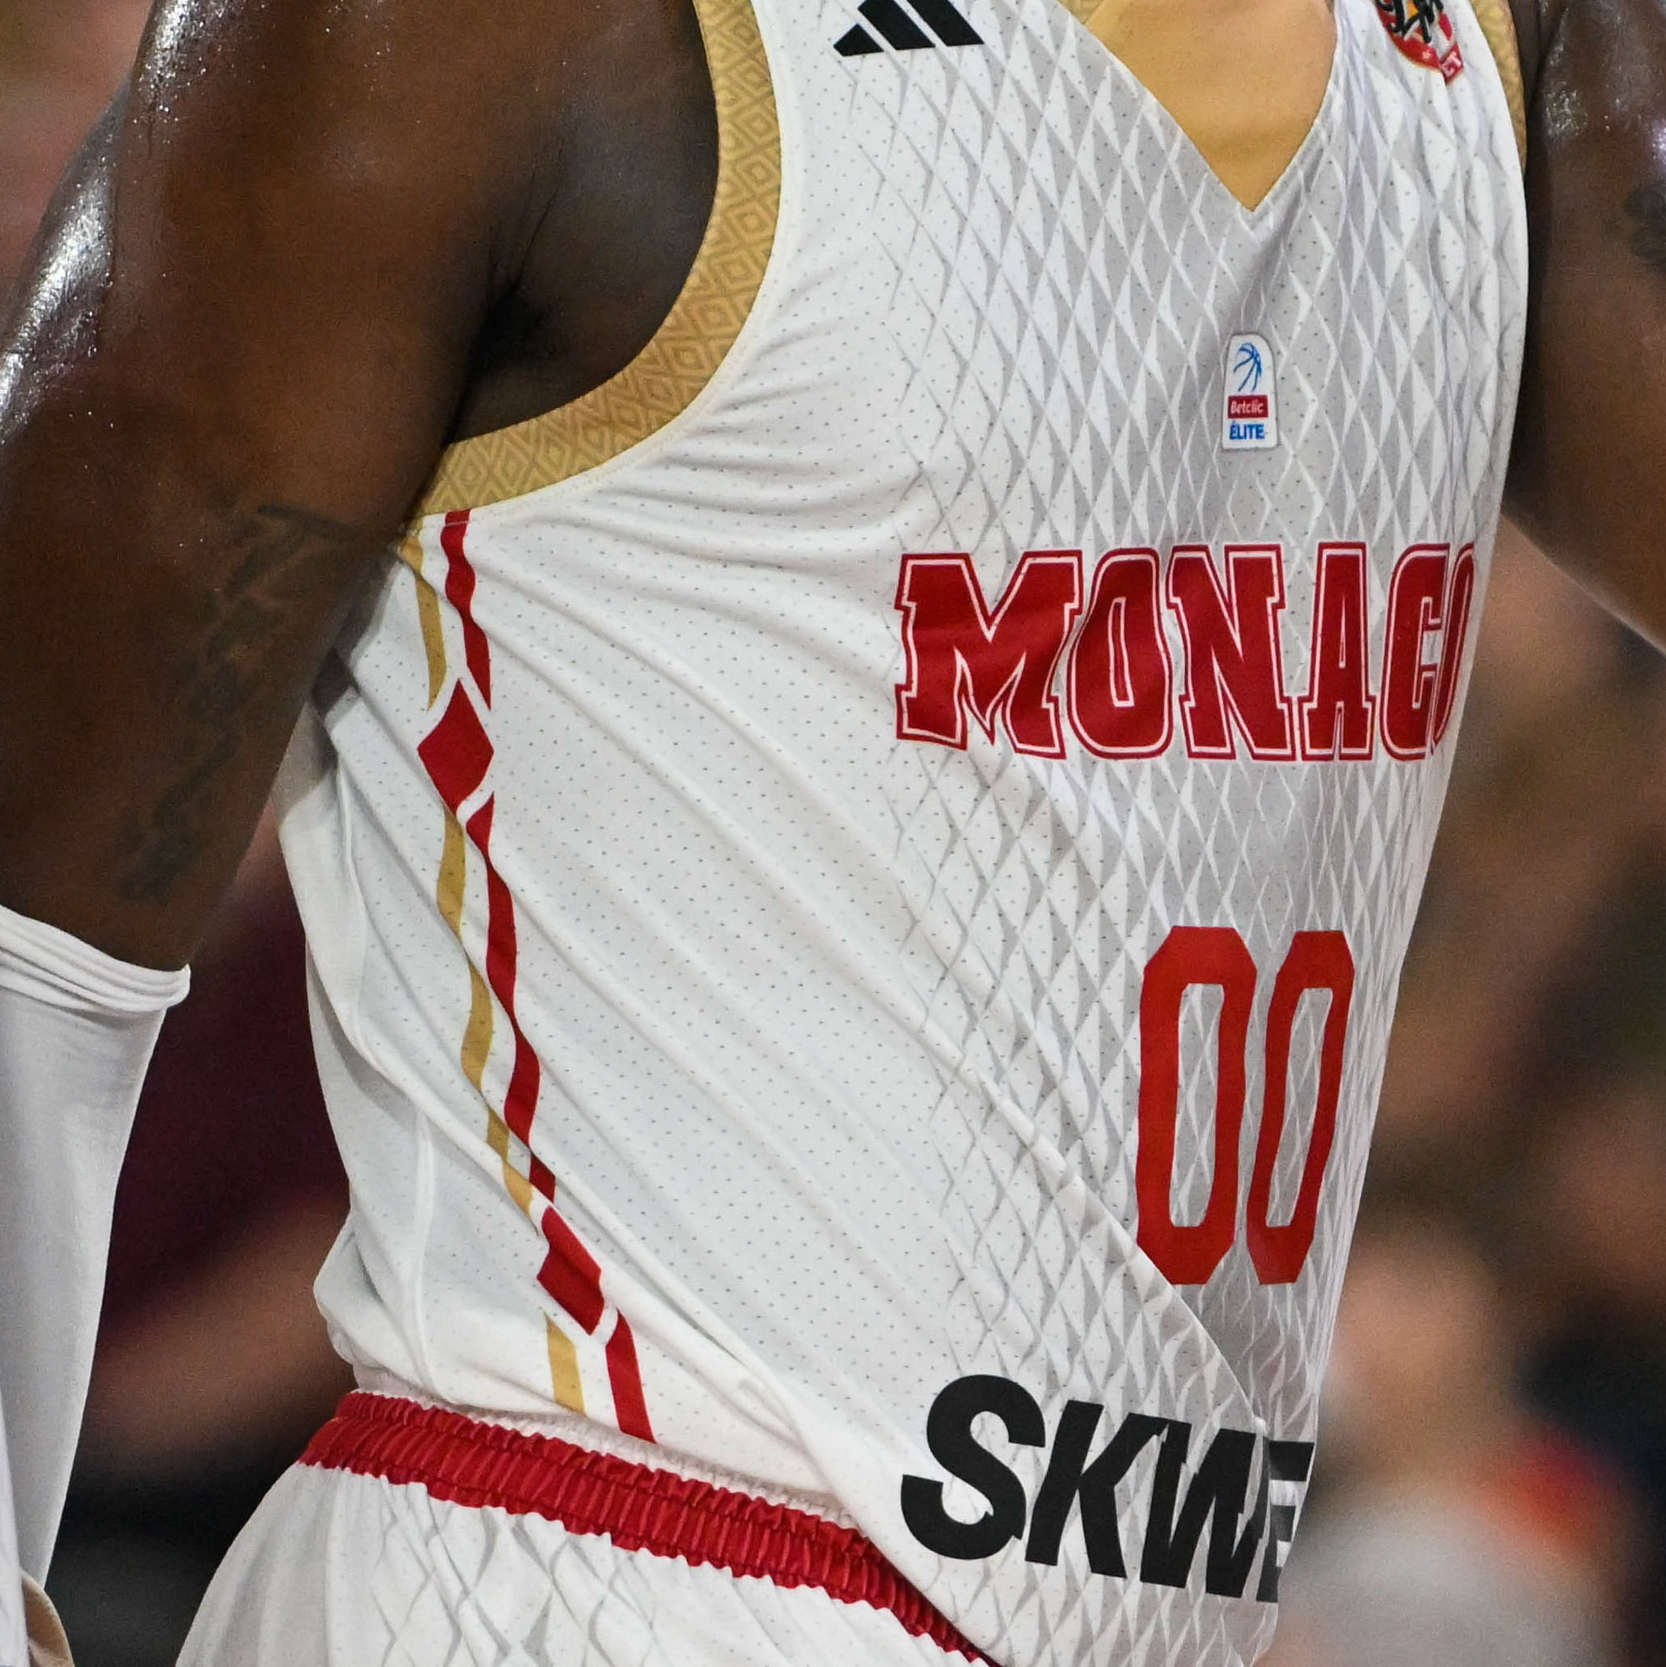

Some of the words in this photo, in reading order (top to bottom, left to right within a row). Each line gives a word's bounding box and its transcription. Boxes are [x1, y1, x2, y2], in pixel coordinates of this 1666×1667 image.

[1230, 399, 1264, 415] Betclic
[1229, 419, 1266, 440] ÉLITE
[1136, 926, 1355, 1285] 00
